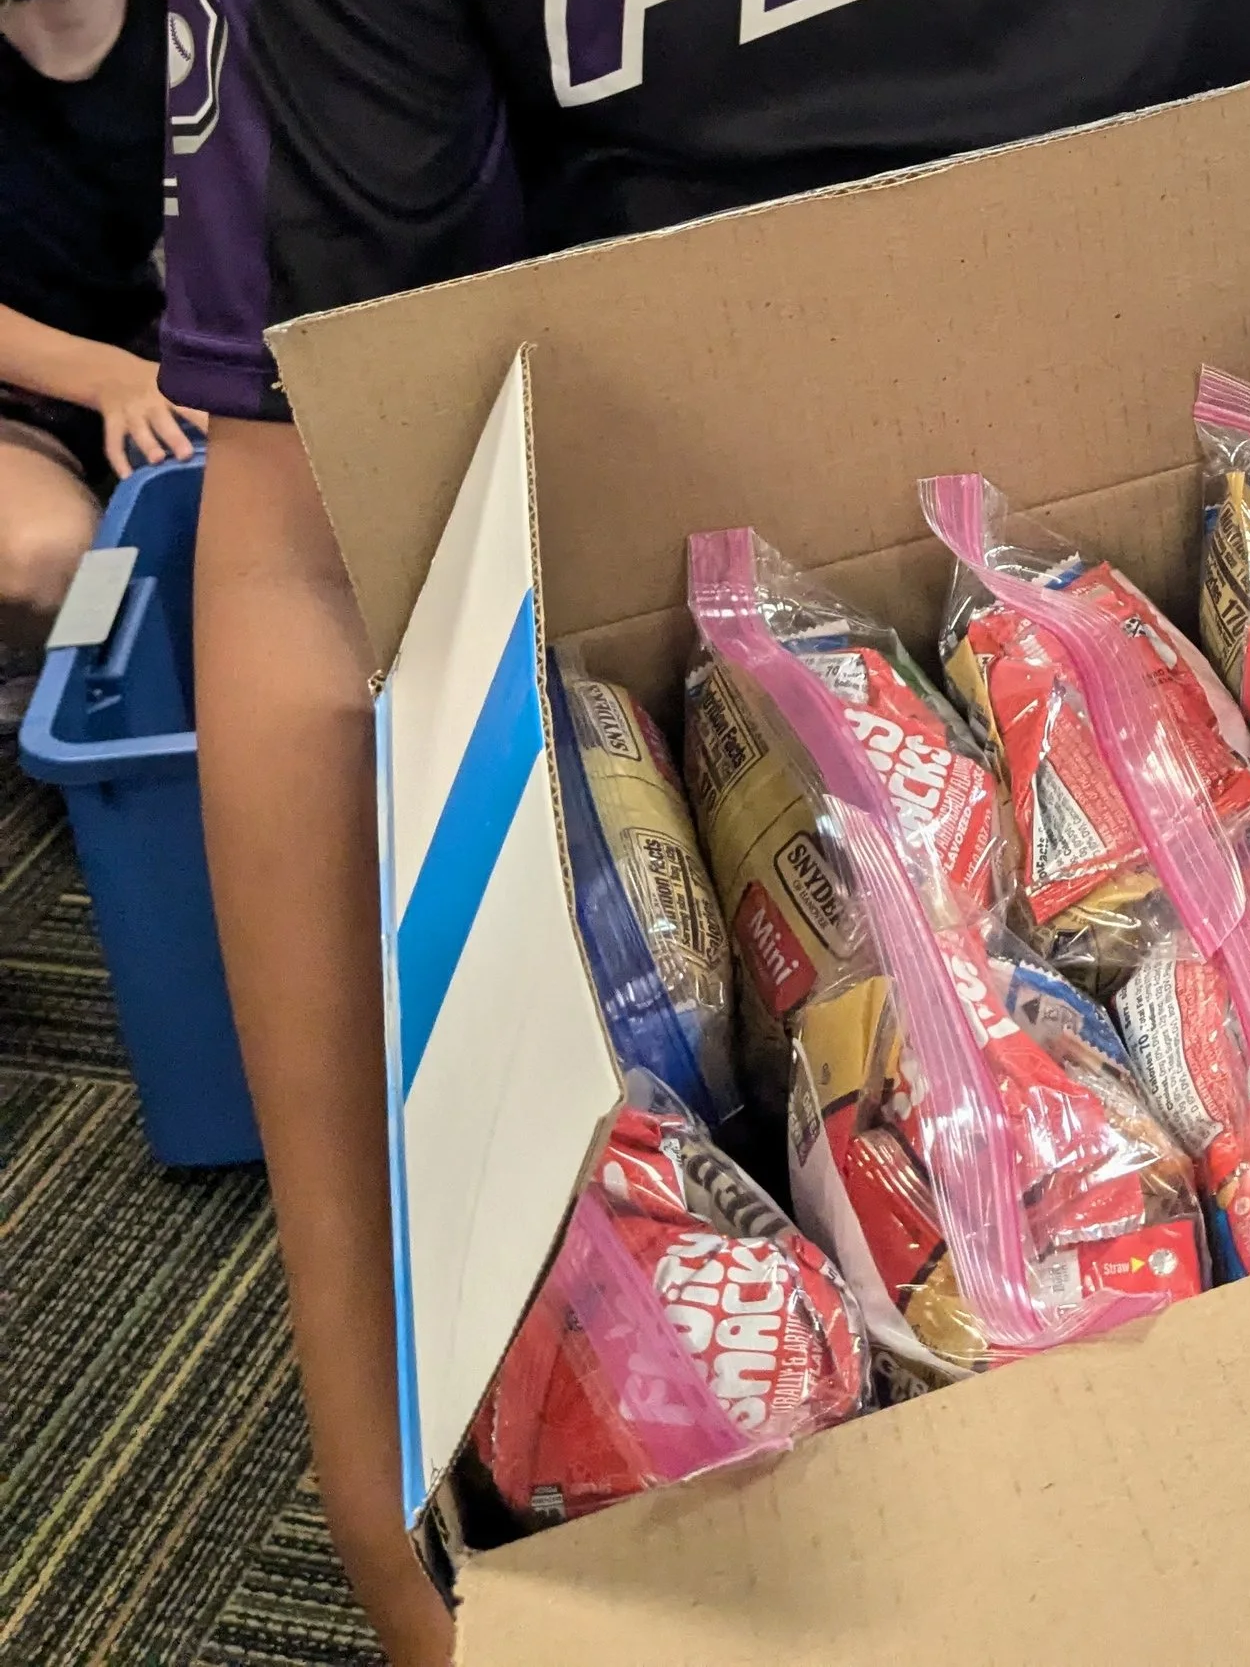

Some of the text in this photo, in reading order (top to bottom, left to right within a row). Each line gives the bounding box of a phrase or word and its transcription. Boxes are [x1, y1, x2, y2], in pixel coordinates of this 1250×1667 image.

[748, 908, 800, 986] Mini
[1138, 1034, 1150, 1054] 70
[1103, 1262, 1130, 1275] Straw
